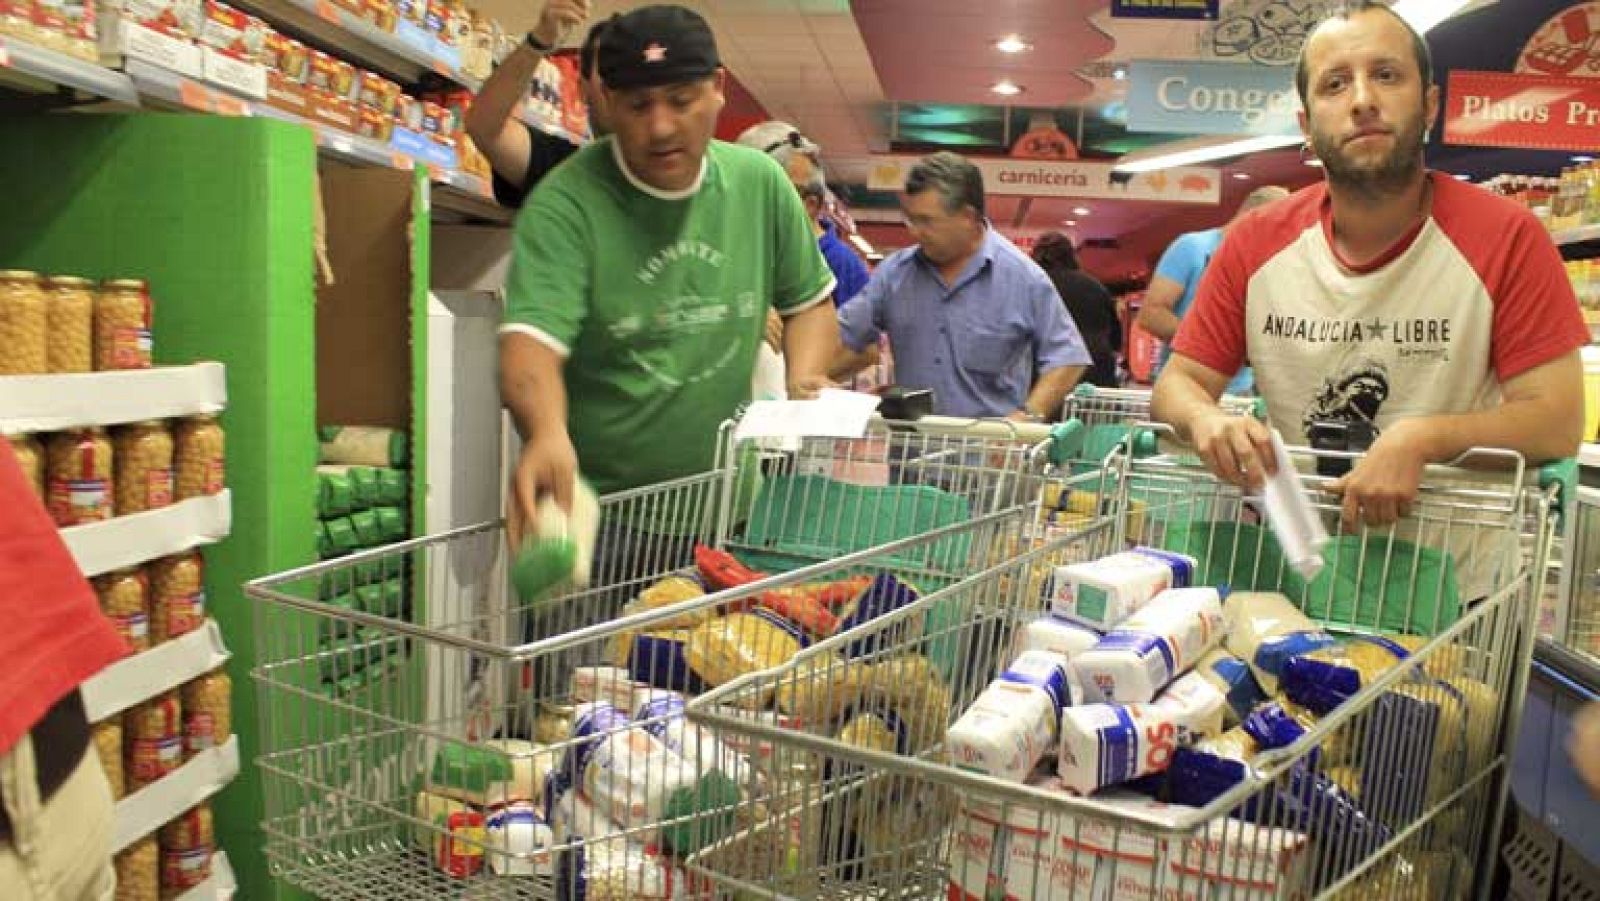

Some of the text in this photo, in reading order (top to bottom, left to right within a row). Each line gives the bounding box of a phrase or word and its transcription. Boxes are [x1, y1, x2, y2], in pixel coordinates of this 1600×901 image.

[1158, 76, 1294, 124] Conge
[1463, 95, 1600, 126] Platos Pr
[1393, 318, 1450, 344] LIBRE
[1146, 721, 1174, 770] OS
